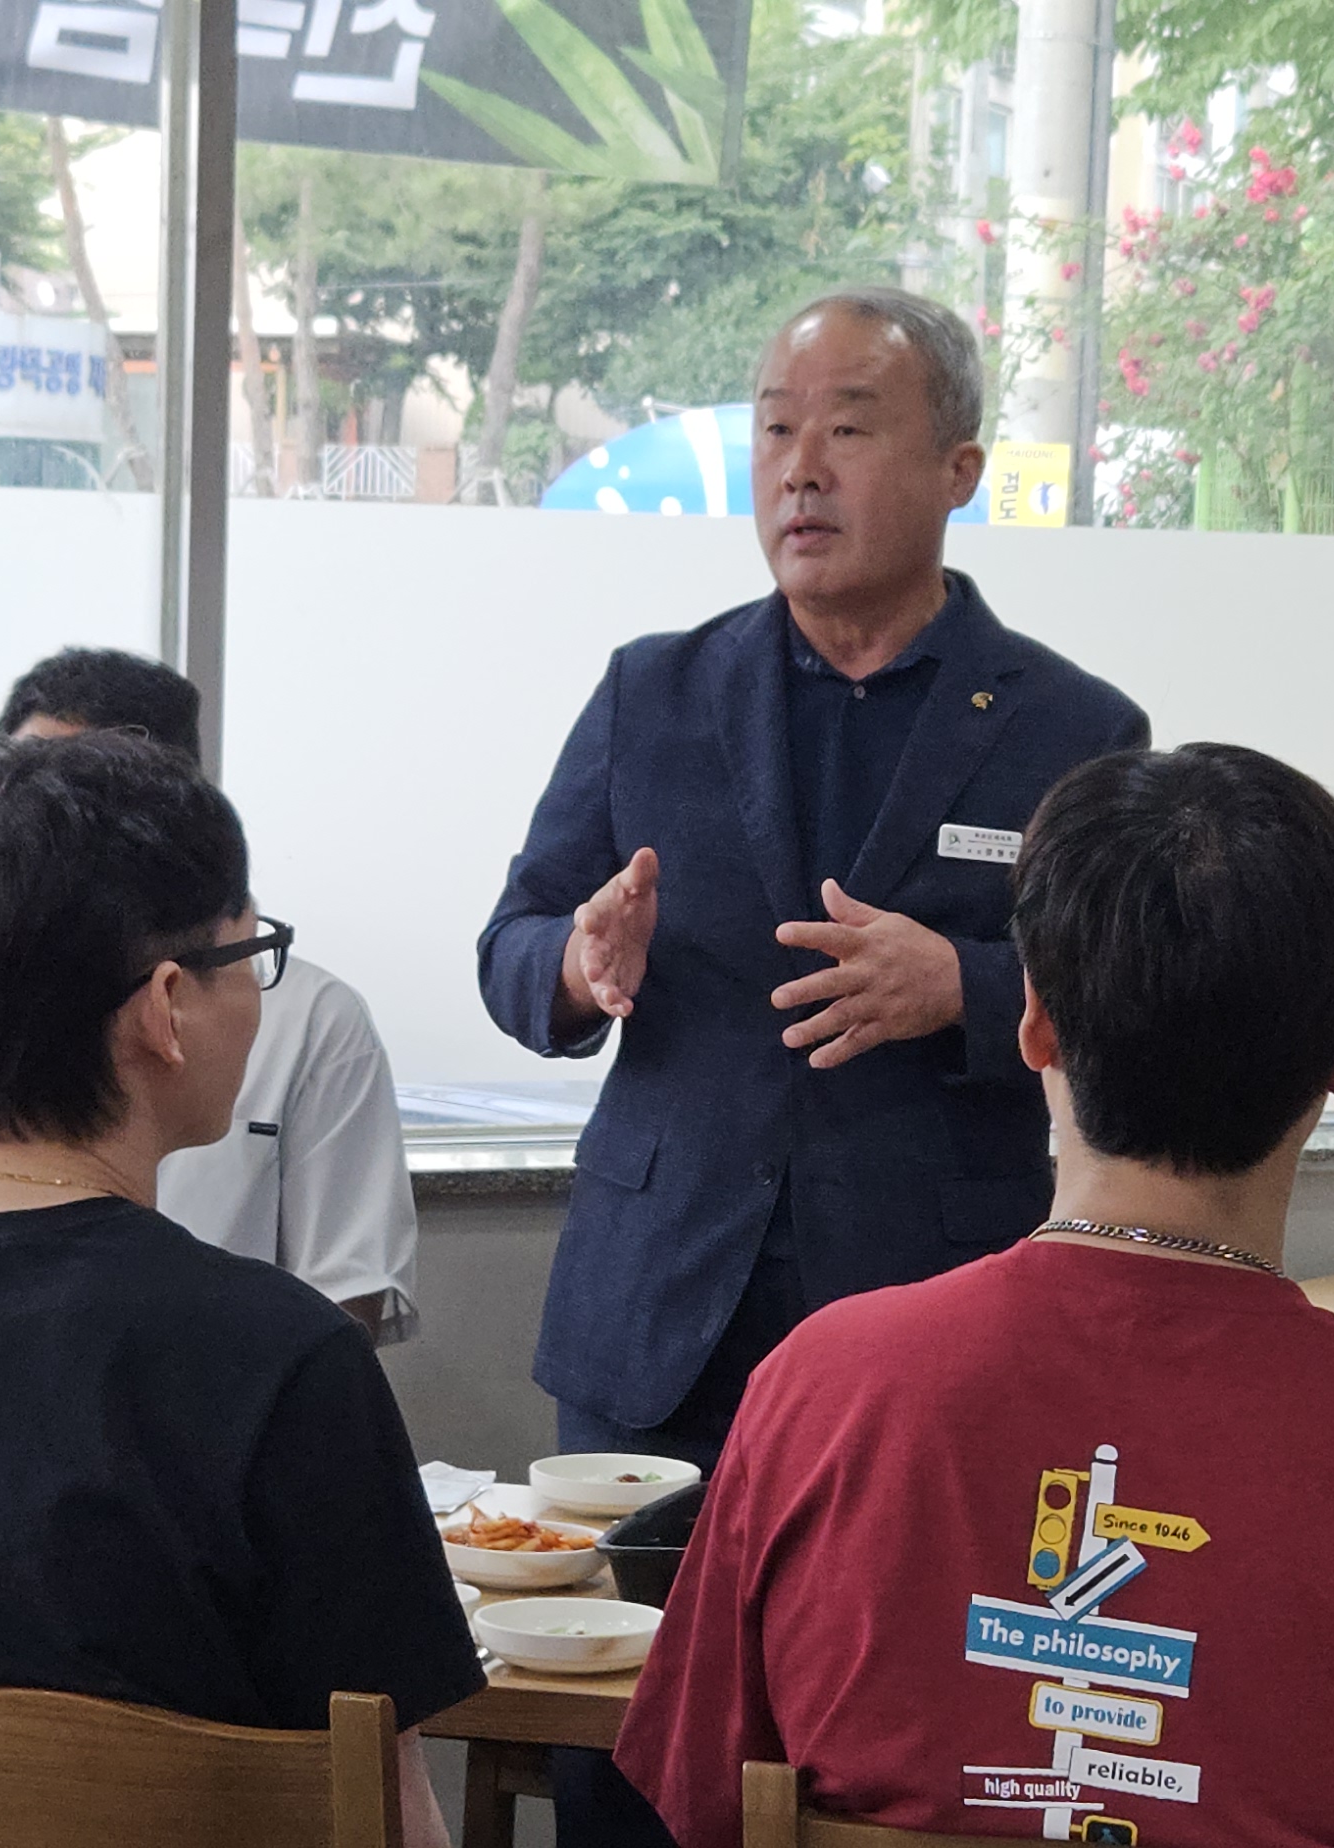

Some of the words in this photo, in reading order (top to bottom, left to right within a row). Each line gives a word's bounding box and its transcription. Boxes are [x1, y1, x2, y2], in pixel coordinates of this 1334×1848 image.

[1103, 1513, 1148, 1533] Since
[979, 1617, 1024, 1646] The
[1032, 1629, 1181, 1679] philosophy
[1044, 1696, 1065, 1715] to
[1071, 1703, 1147, 1730] provide
[984, 1777, 1020, 1798] high
[1087, 1761, 1183, 1793] reliable,
